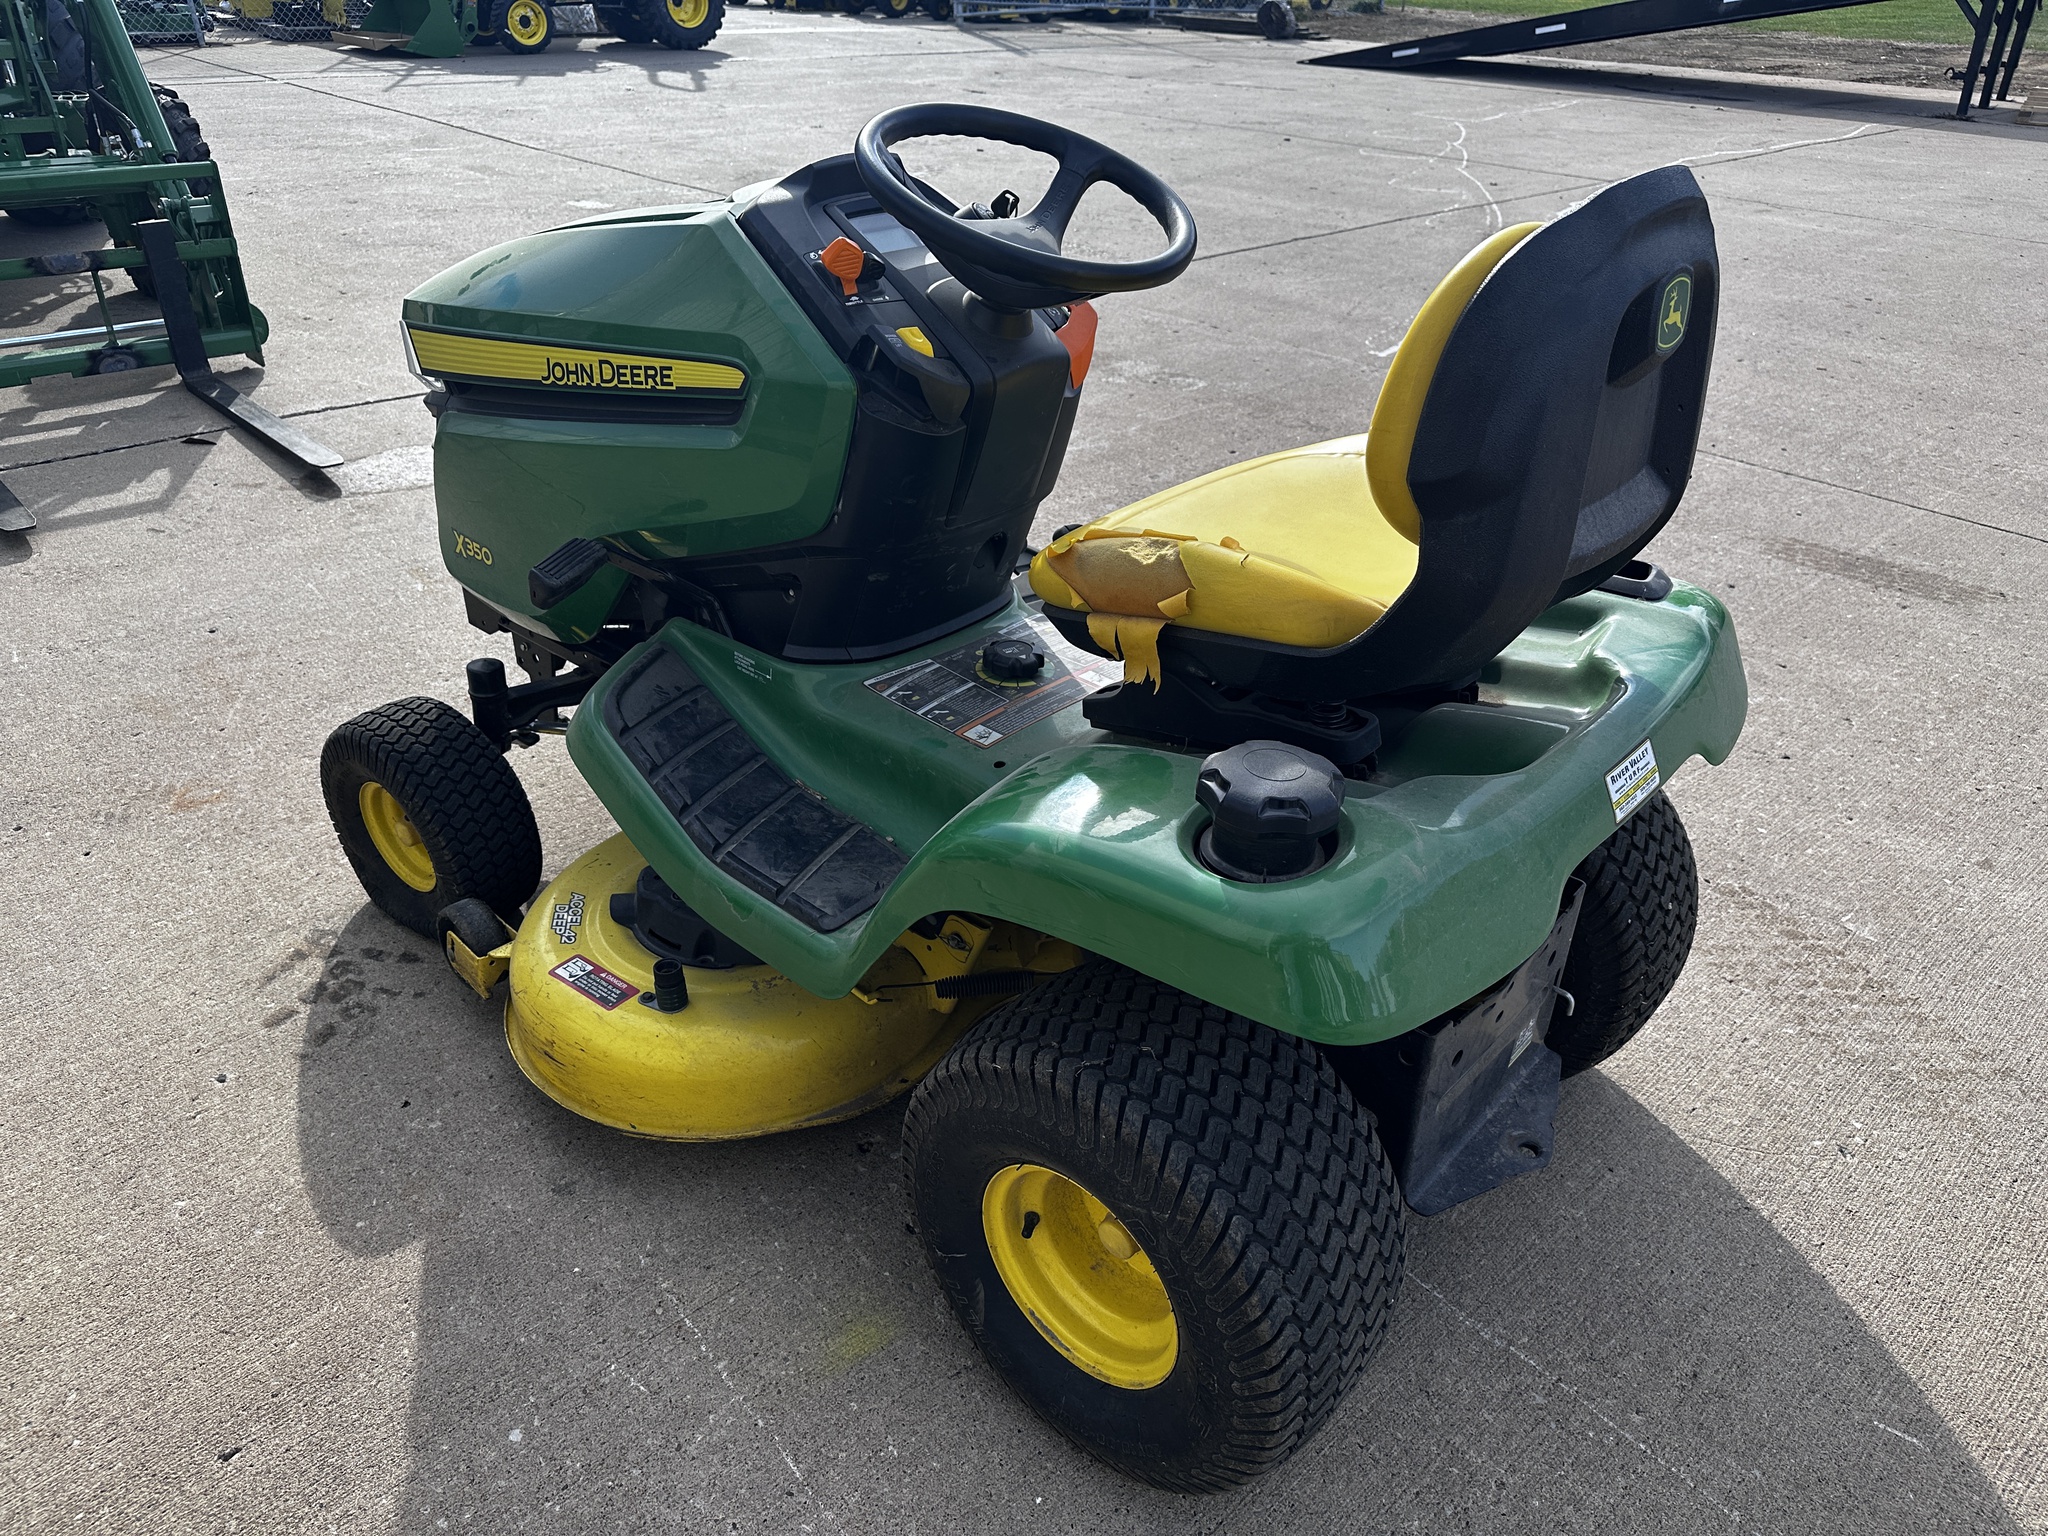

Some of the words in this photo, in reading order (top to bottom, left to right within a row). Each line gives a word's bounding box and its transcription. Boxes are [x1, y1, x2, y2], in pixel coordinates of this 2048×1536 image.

[541, 357, 595, 385] JOHN
[598, 359, 675, 388] DEERE
[453, 529, 493, 566] X350
[1610, 764, 1630, 785] RIVER
[1628, 747, 1649, 769] VALLEY
[1624, 766, 1640, 784] TURF
[551, 904, 570, 936] DEEP
[605, 975, 628, 990] DANGER
